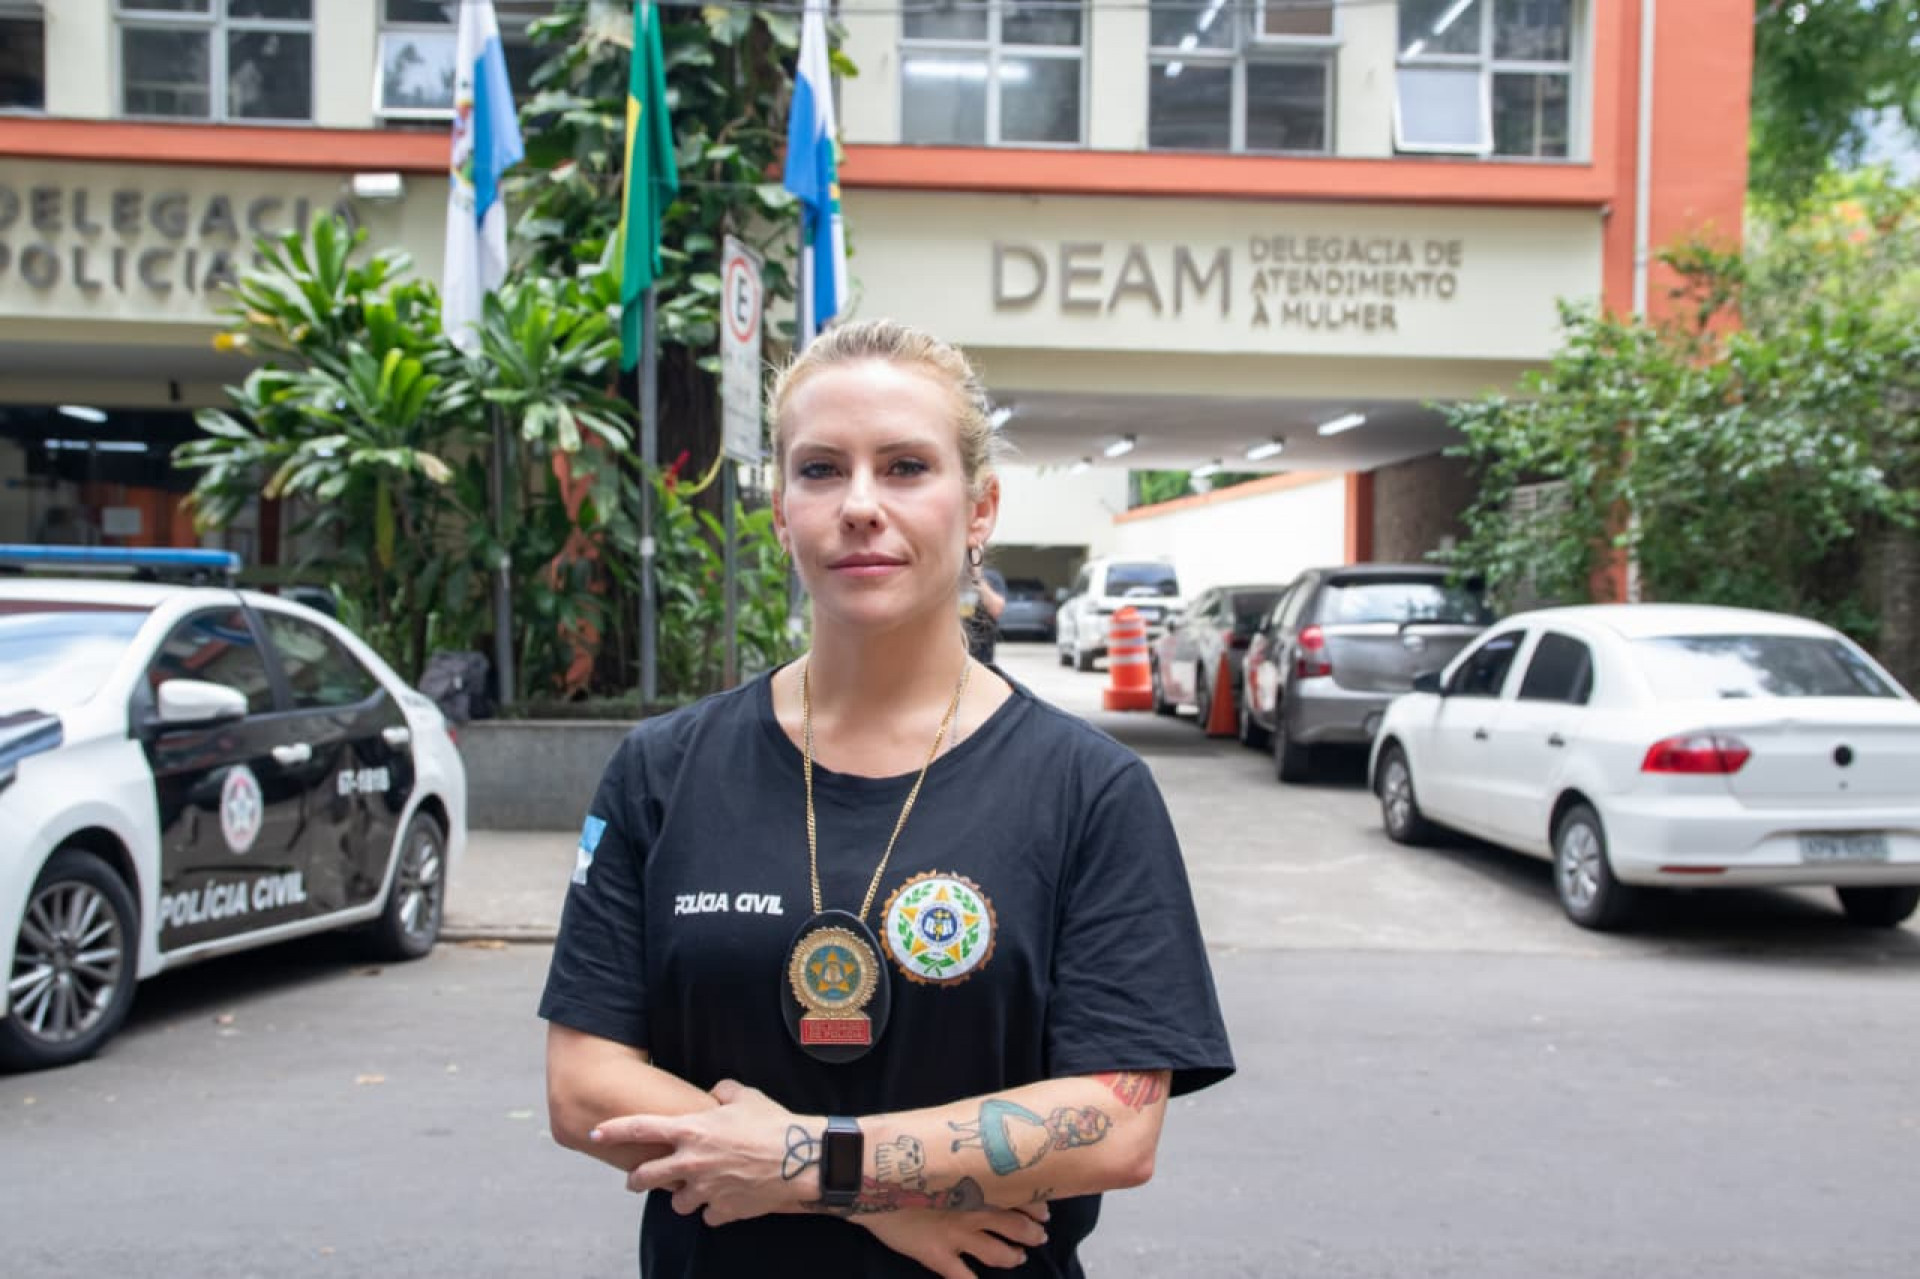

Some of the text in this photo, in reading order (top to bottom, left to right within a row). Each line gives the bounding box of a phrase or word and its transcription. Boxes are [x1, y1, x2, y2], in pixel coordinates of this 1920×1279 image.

[1249, 236, 1463, 267] DELEGACIA DE
[991, 241, 1233, 319] DEAM
[1251, 267, 1457, 299] ATENDIMENTO
[736, 274, 748, 324] E
[1281, 300, 1398, 332] MULHER
[252, 871, 306, 912] CIVIL
[734, 892, 784, 916] CIVIL
